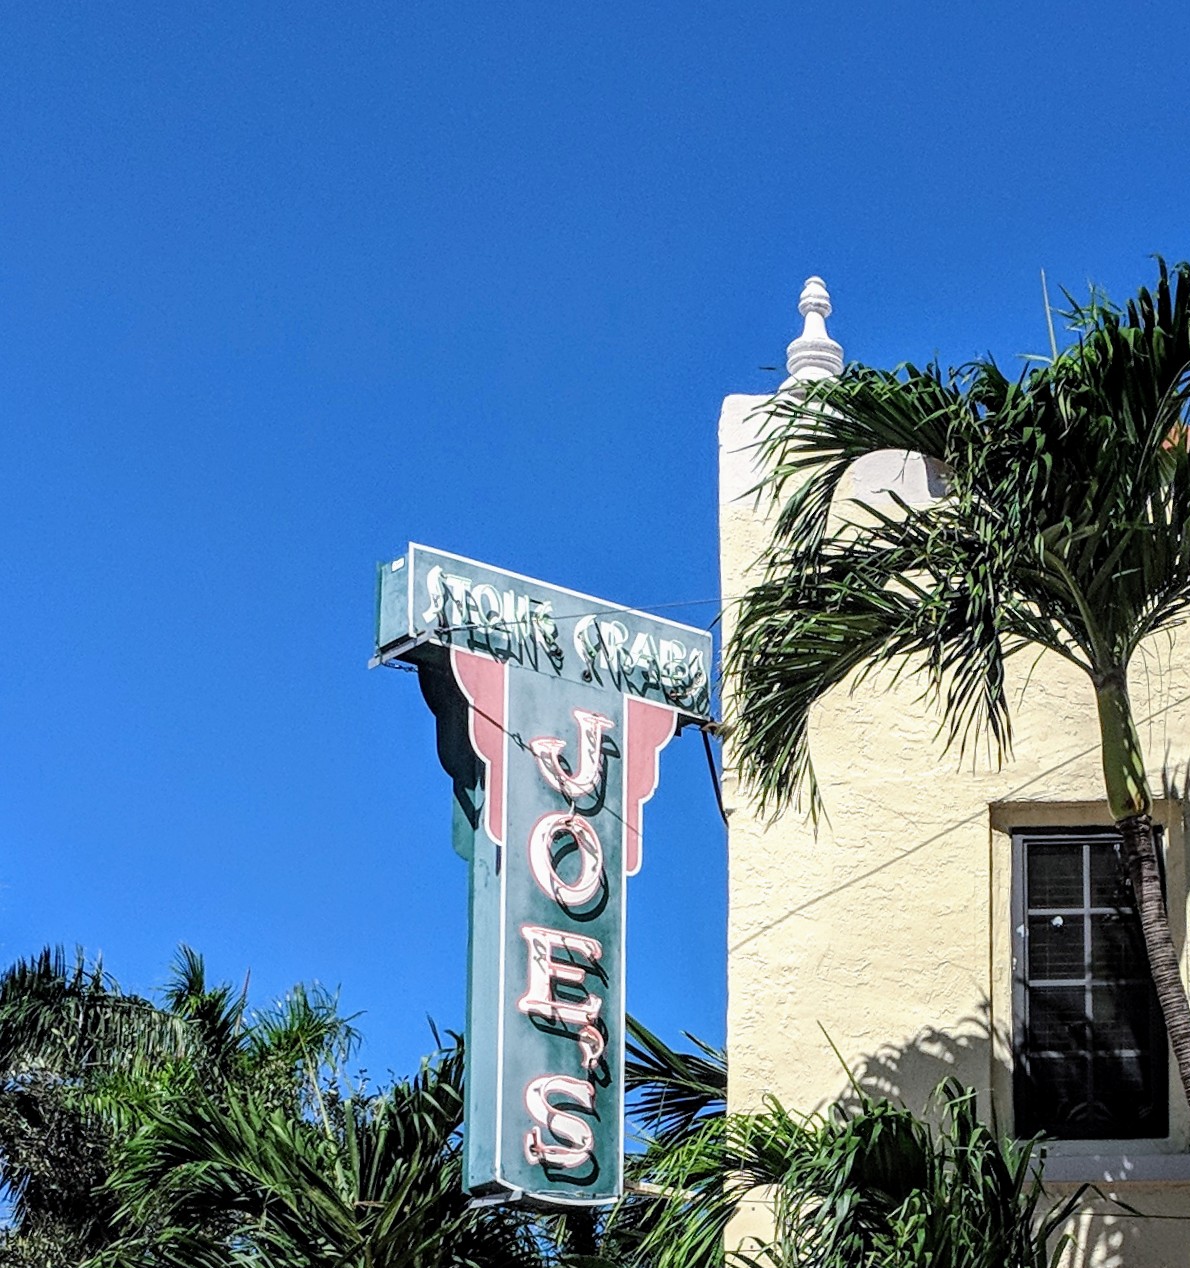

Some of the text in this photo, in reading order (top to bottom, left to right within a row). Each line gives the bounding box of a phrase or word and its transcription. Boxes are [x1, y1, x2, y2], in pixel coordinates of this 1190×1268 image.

[422, 564, 708, 698] STONE CRABS
[518, 708, 615, 1170] JOE'S
